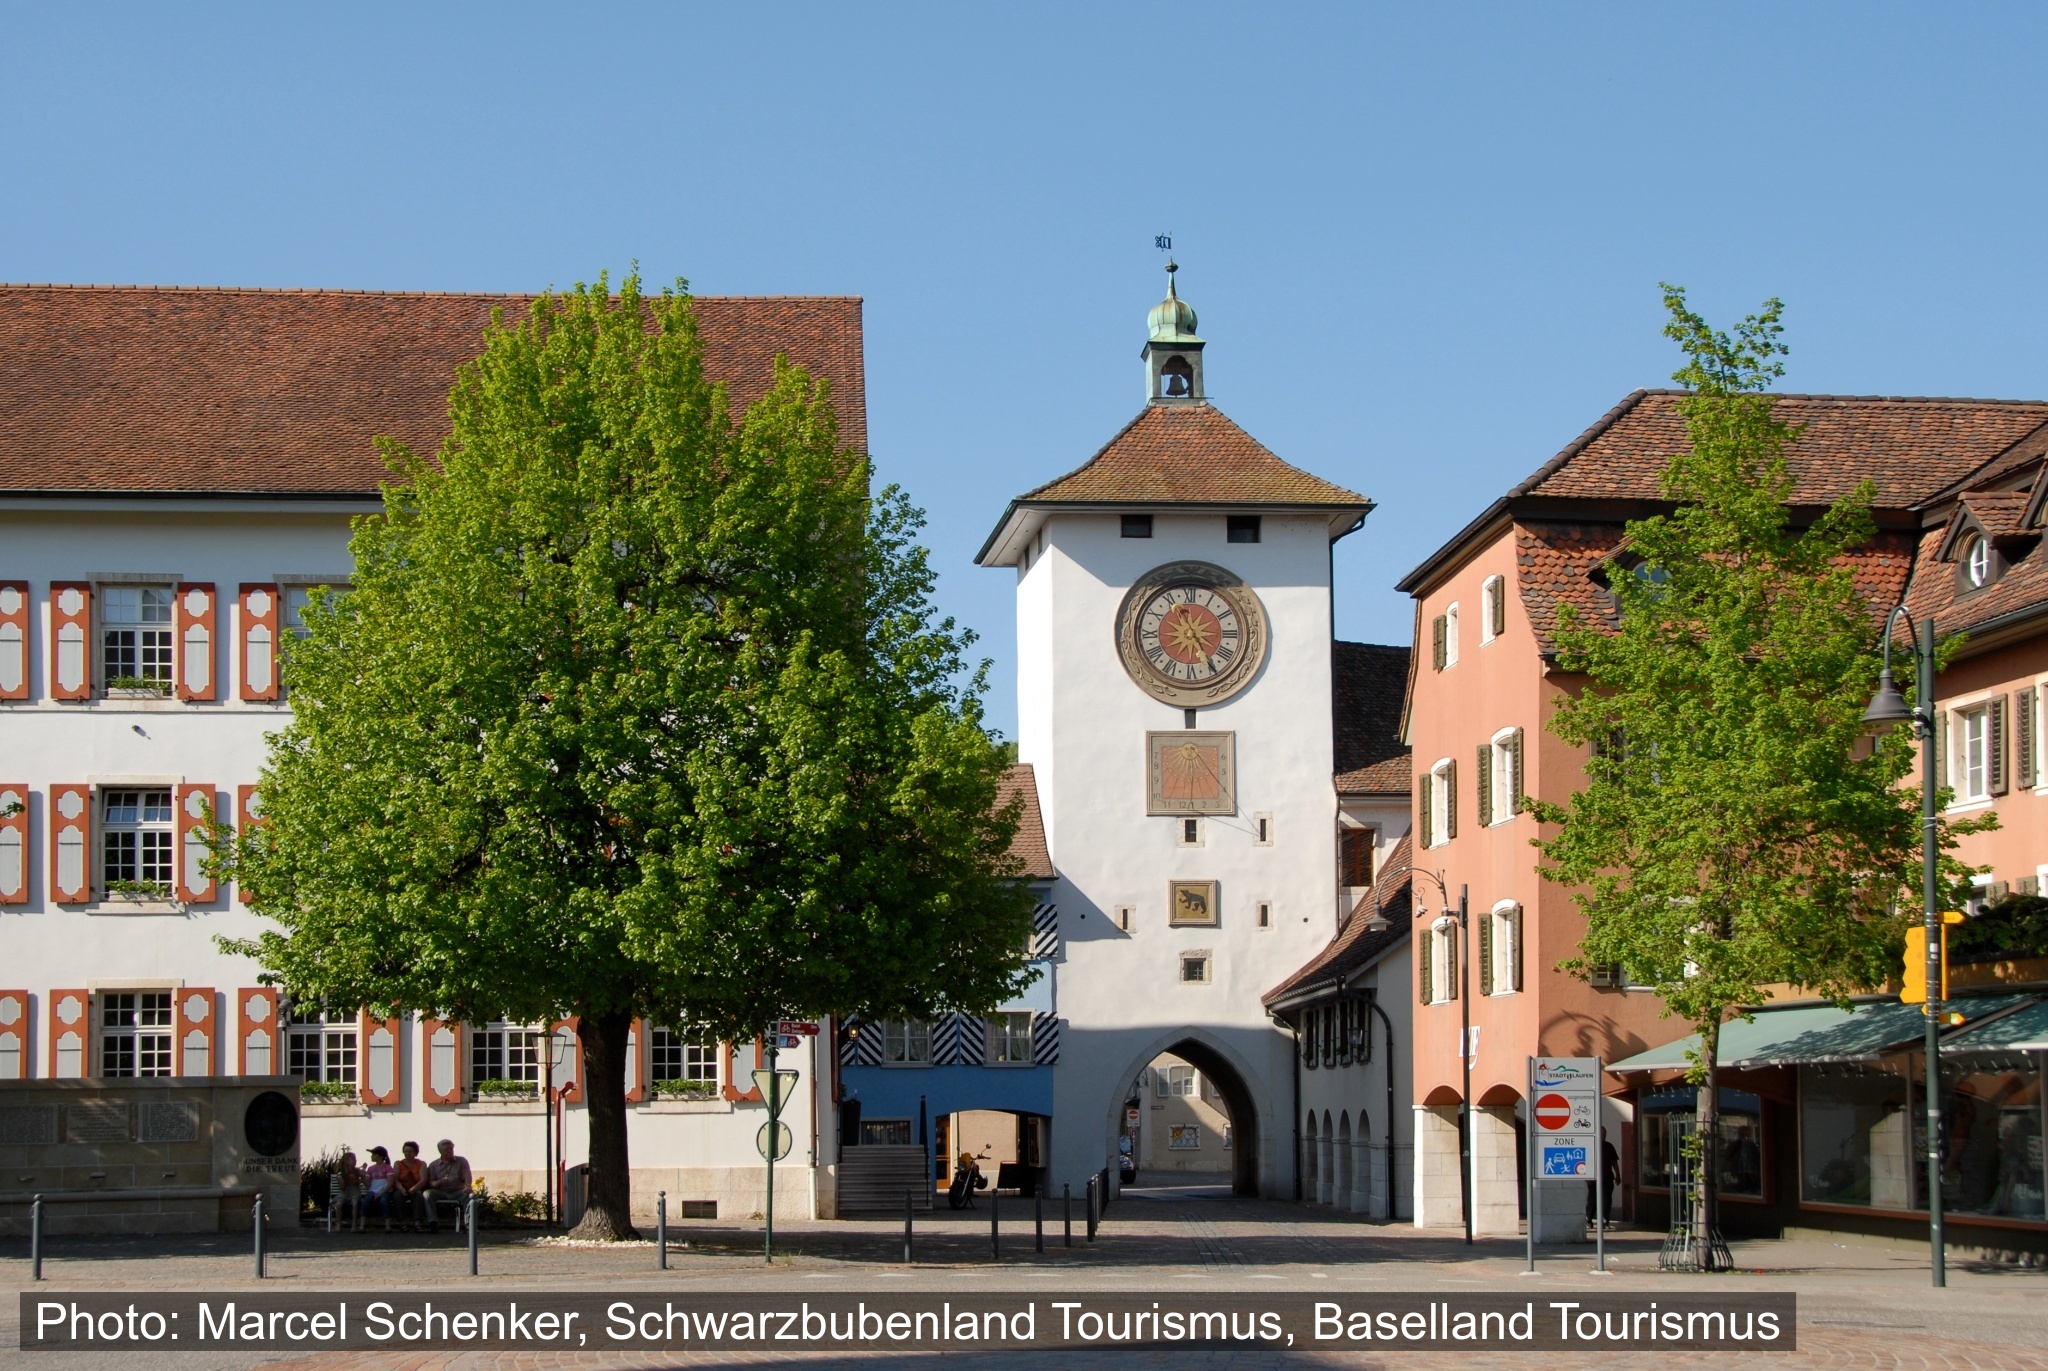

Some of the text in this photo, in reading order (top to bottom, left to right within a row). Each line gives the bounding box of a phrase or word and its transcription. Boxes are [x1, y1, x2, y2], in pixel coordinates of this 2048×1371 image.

[1162, 592, 1176, 608] XI
[1183, 588, 1197, 604] XII
[1206, 594, 1215, 607] I
[1147, 608, 1164, 621] X
[1217, 609, 1233, 620] II
[1142, 629, 1158, 639] IX
[1222, 629, 1238, 639] III
[1215, 645, 1234, 662] IIII
[1154, 752, 1159, 760] 7
[1154, 761, 1159, 770] 8
[1163, 801, 1171, 809] 11
[1179, 801, 1187, 809] 12
[1201, 801, 1207, 809] 2
[1215, 801, 1220, 809] 3
[1554, 1138, 1575, 1146] ZONE
[245, 1157, 299, 1165] UNSER DANK
